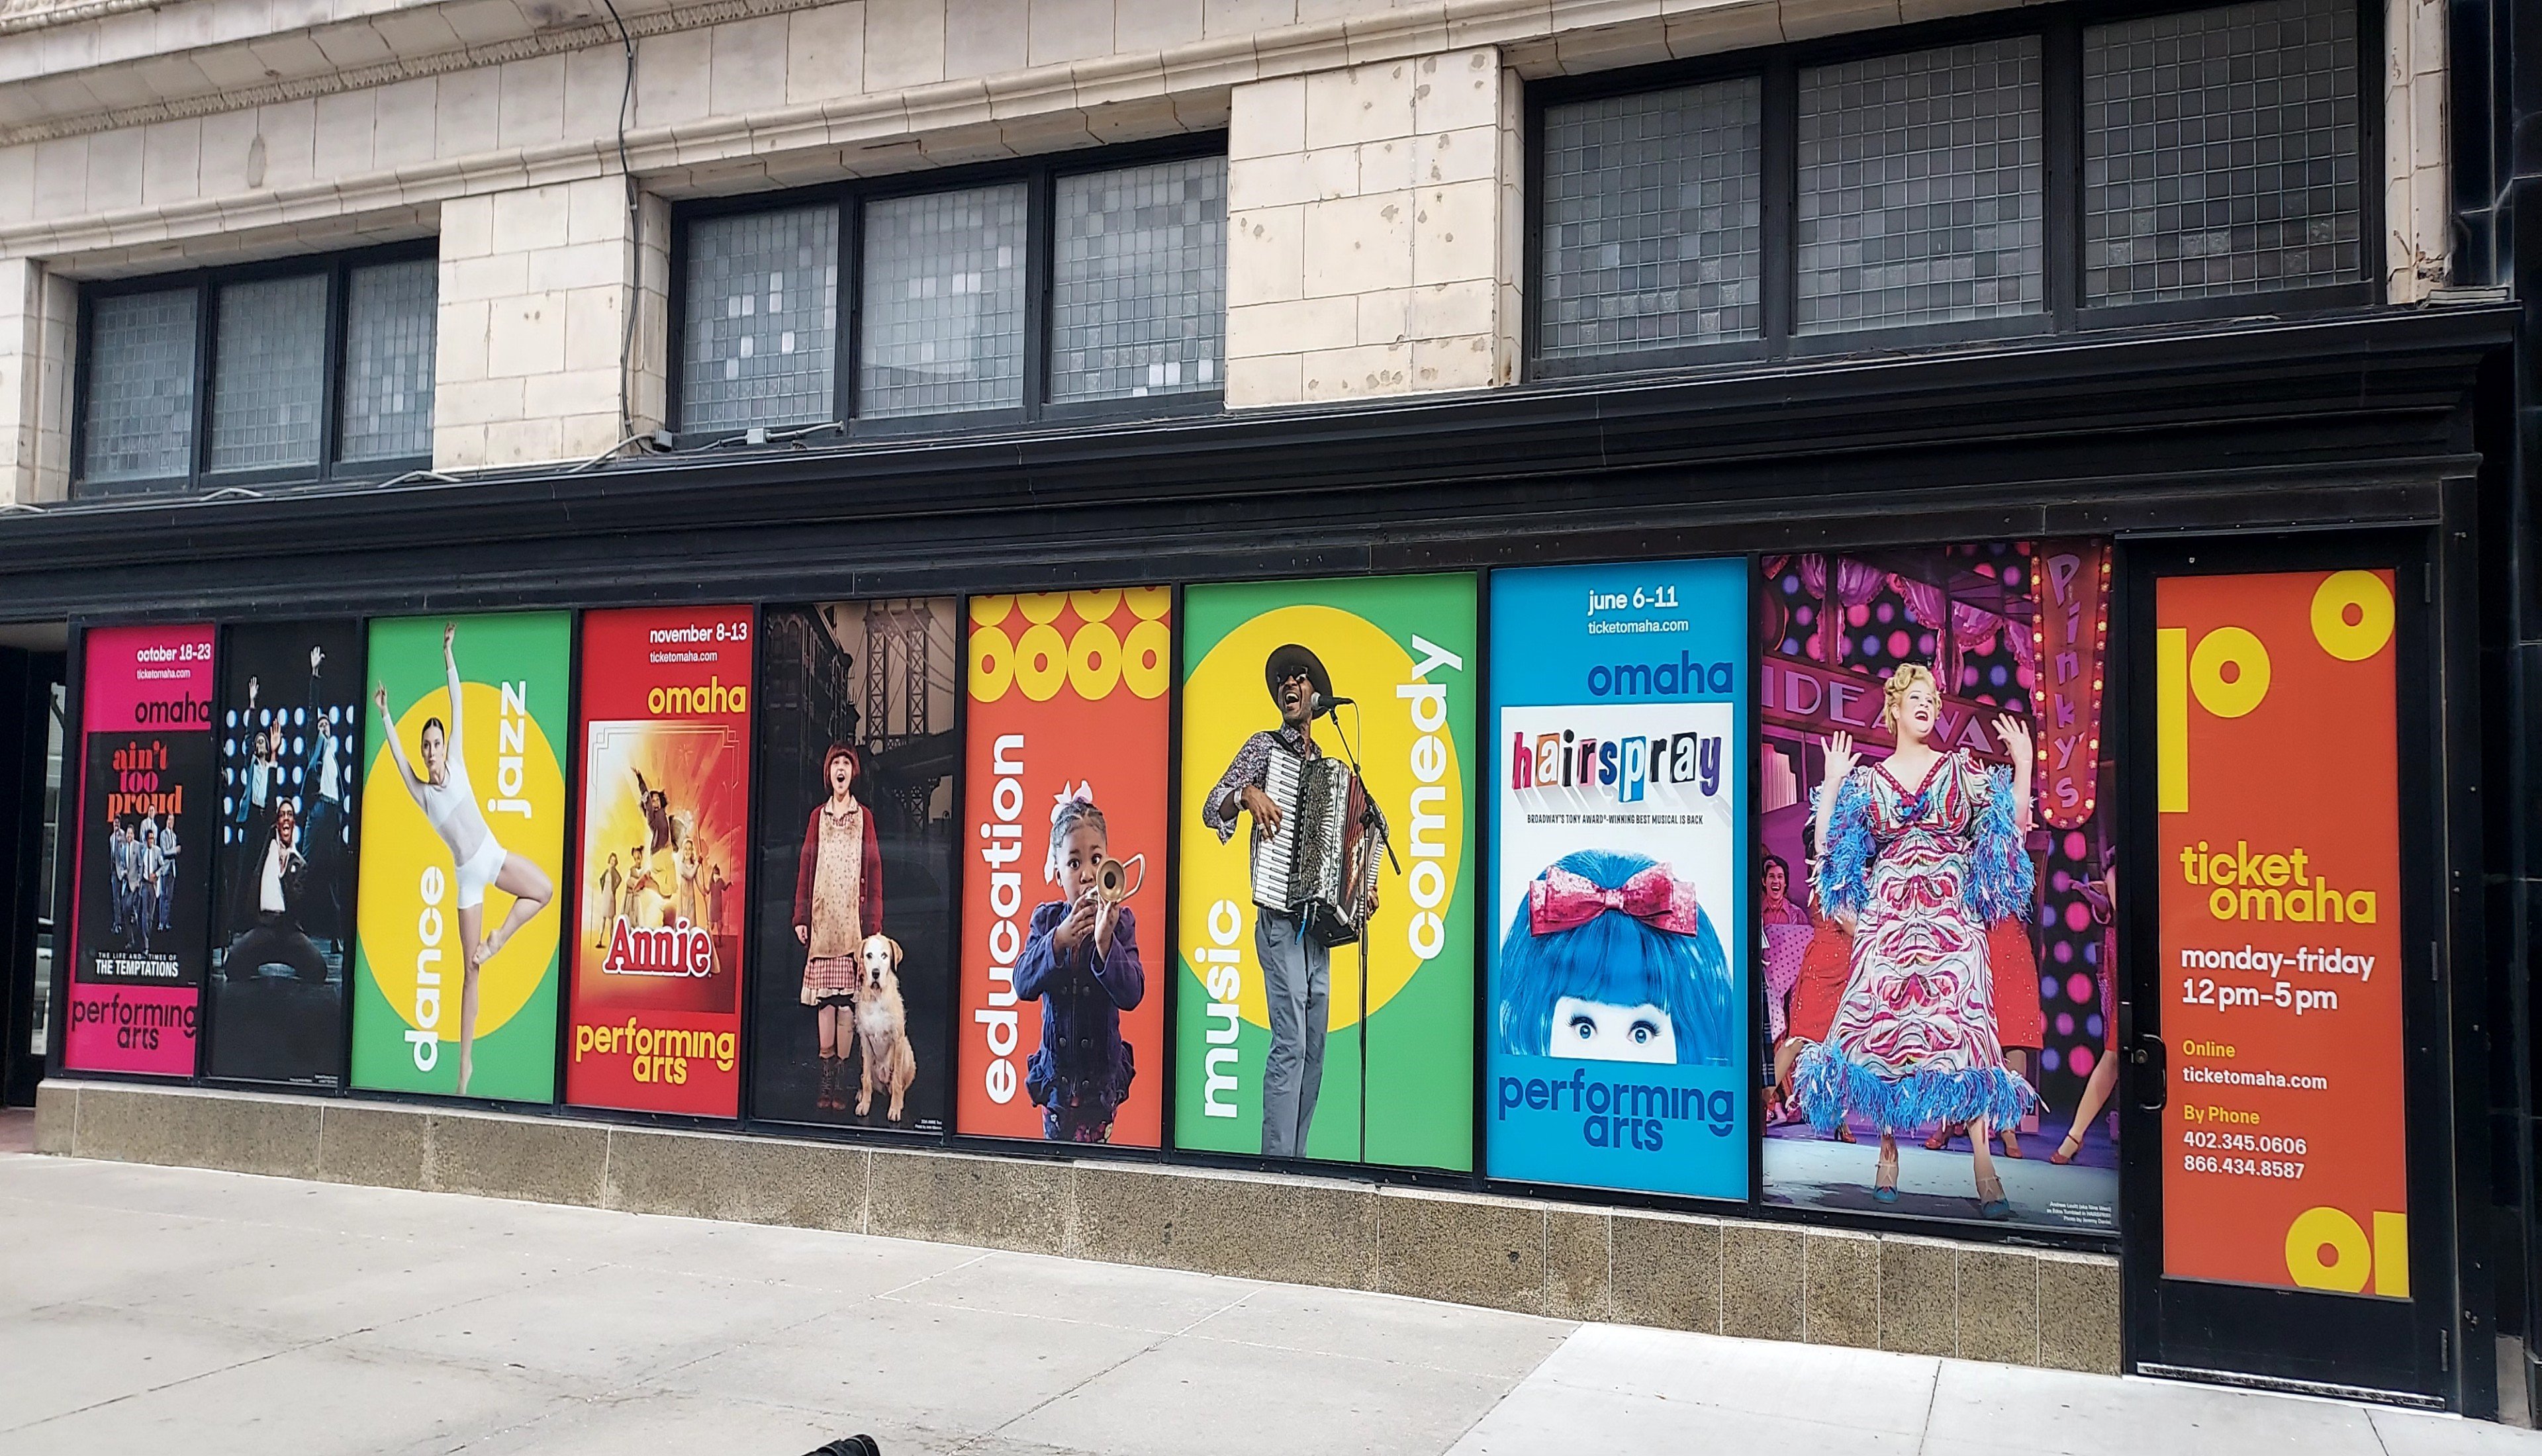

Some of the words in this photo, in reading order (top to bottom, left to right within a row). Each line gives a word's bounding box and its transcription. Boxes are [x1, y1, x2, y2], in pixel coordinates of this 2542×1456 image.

[1587, 590, 1628, 616] june
[1632, 586, 1679, 609] 6-11
[649, 624, 713, 643] november
[716, 622, 747, 641] 8-13
[1587, 619, 1689, 635] ticketomaha.com
[136, 645, 177, 662] october
[179, 643, 211, 660] 18-23
[649, 650, 718, 663] ticketomaha.com
[136, 668, 191, 679] ticketomaha.com
[1587, 650, 1734, 696] omaha
[134, 690, 212, 723] omaha
[647, 675, 747, 715] omaha
[113, 740, 168, 770] ain't
[487, 680, 532, 819] jazz
[120, 767, 159, 793] too
[1511, 729, 1722, 805] hairspray
[107, 784, 183, 823] proud
[1396, 633, 1463, 960] comedy
[1527, 813, 1565, 824] BROADWAY'S
[1566, 814, 1581, 824] TONY
[1636, 814, 1651, 825] BEST
[1652, 814, 1679, 825] MUSICAL
[1679, 815, 1686, 825] IS
[1687, 815, 1703, 825] BACK
[2179, 840, 2309, 887] ticket
[2209, 876, 2377, 924] omaha
[974, 733, 1025, 1105] education
[603, 916, 712, 977] Annie
[2181, 944, 2375, 982] monday-friday
[95, 959, 114, 975] THE
[115, 960, 179, 977] TEMPTATIONS
[404, 866, 446, 1072] dance
[71, 993, 198, 1038] performing
[1196, 899, 1242, 1119] music
[117, 1026, 160, 1050] arts
[575, 1017, 735, 1072] performing
[2183, 1040, 2236, 1058] Online
[632, 1055, 688, 1085] arts
[2183, 1066, 2328, 1090] ticketomaha.com
[1498, 1068, 1734, 1138] performing
[2184, 1104, 2204, 1124] By
[2208, 1105, 2261, 1125] Phone
[1583, 1115, 1664, 1152] arts
[2183, 1131, 2308, 1156] 402.345.0606
[2184, 1155, 2305, 1179] 866.434.8587
